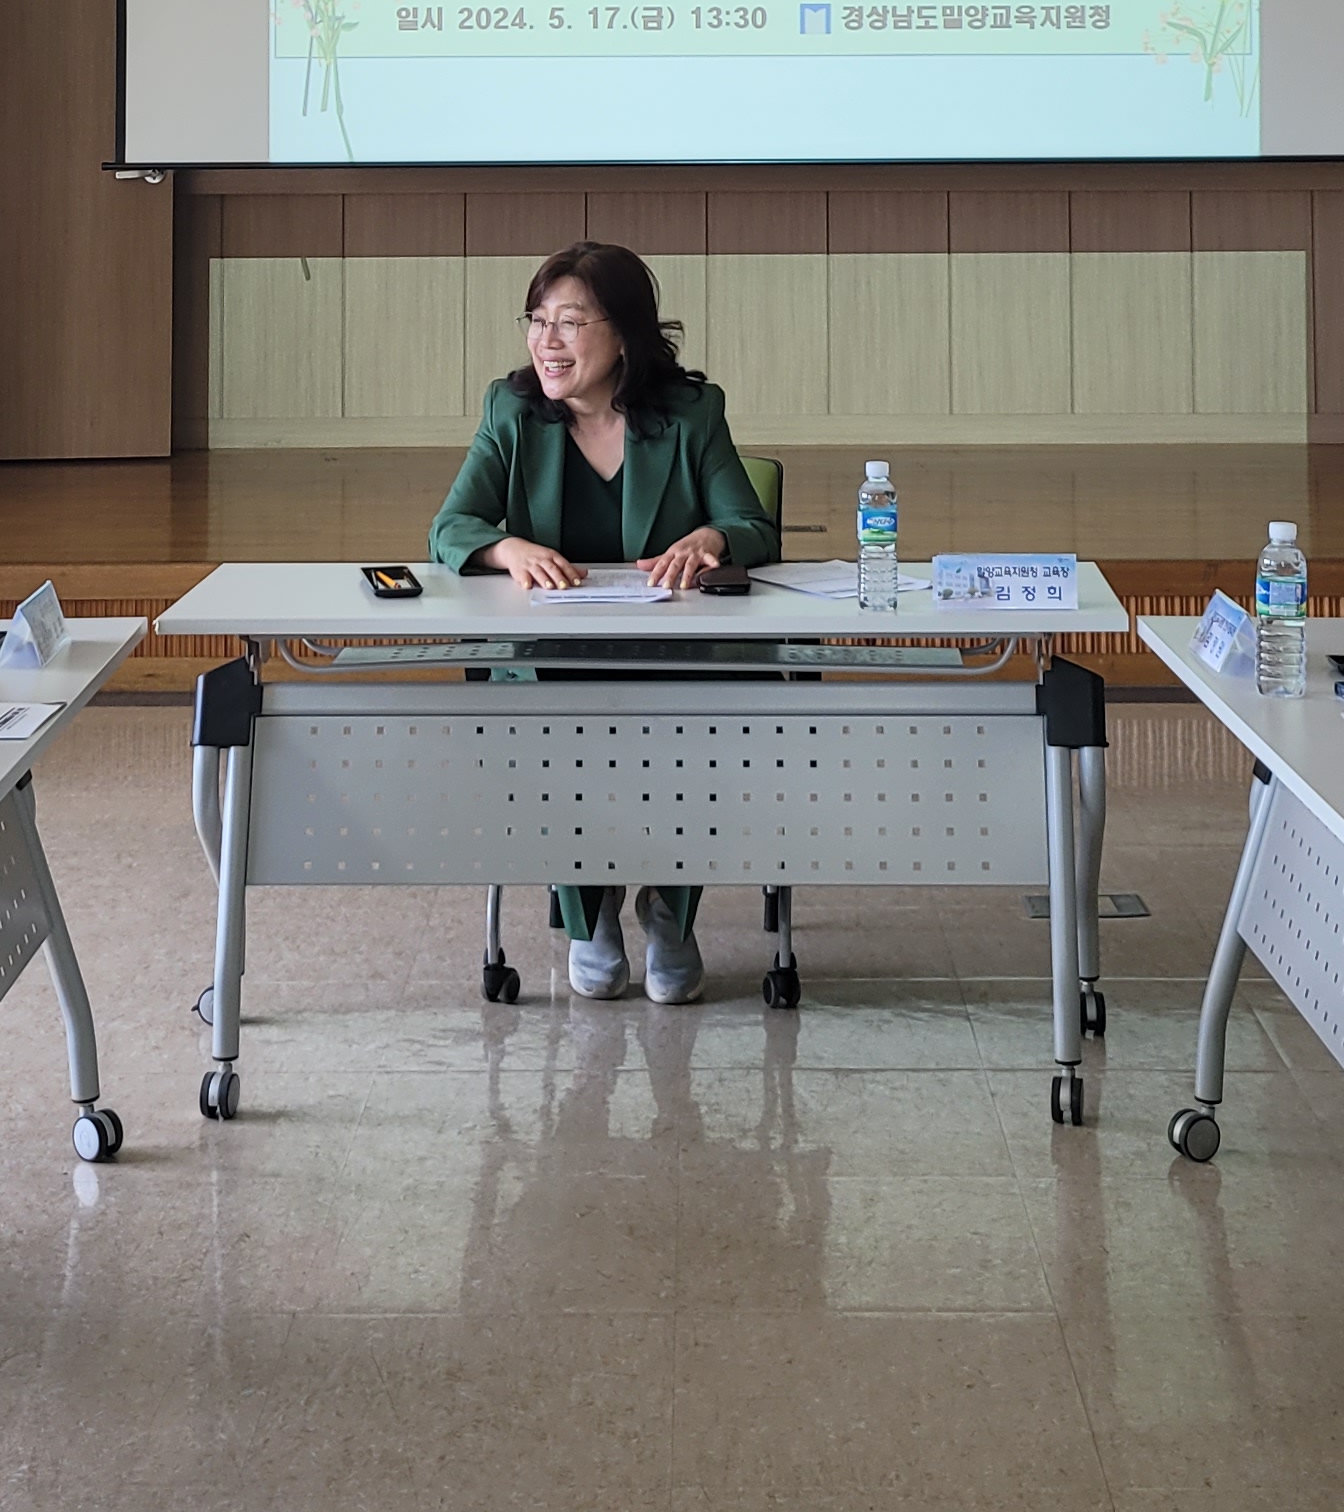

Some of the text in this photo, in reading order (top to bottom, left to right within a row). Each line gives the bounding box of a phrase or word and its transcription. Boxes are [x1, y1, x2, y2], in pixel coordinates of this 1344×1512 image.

[396, 4, 1112, 31] 일시 2024. 5. 17.(금) 13:30 경상남도밀양교육지원청
[976, 566, 1070, 579] 밀양교육지원청 교육장
